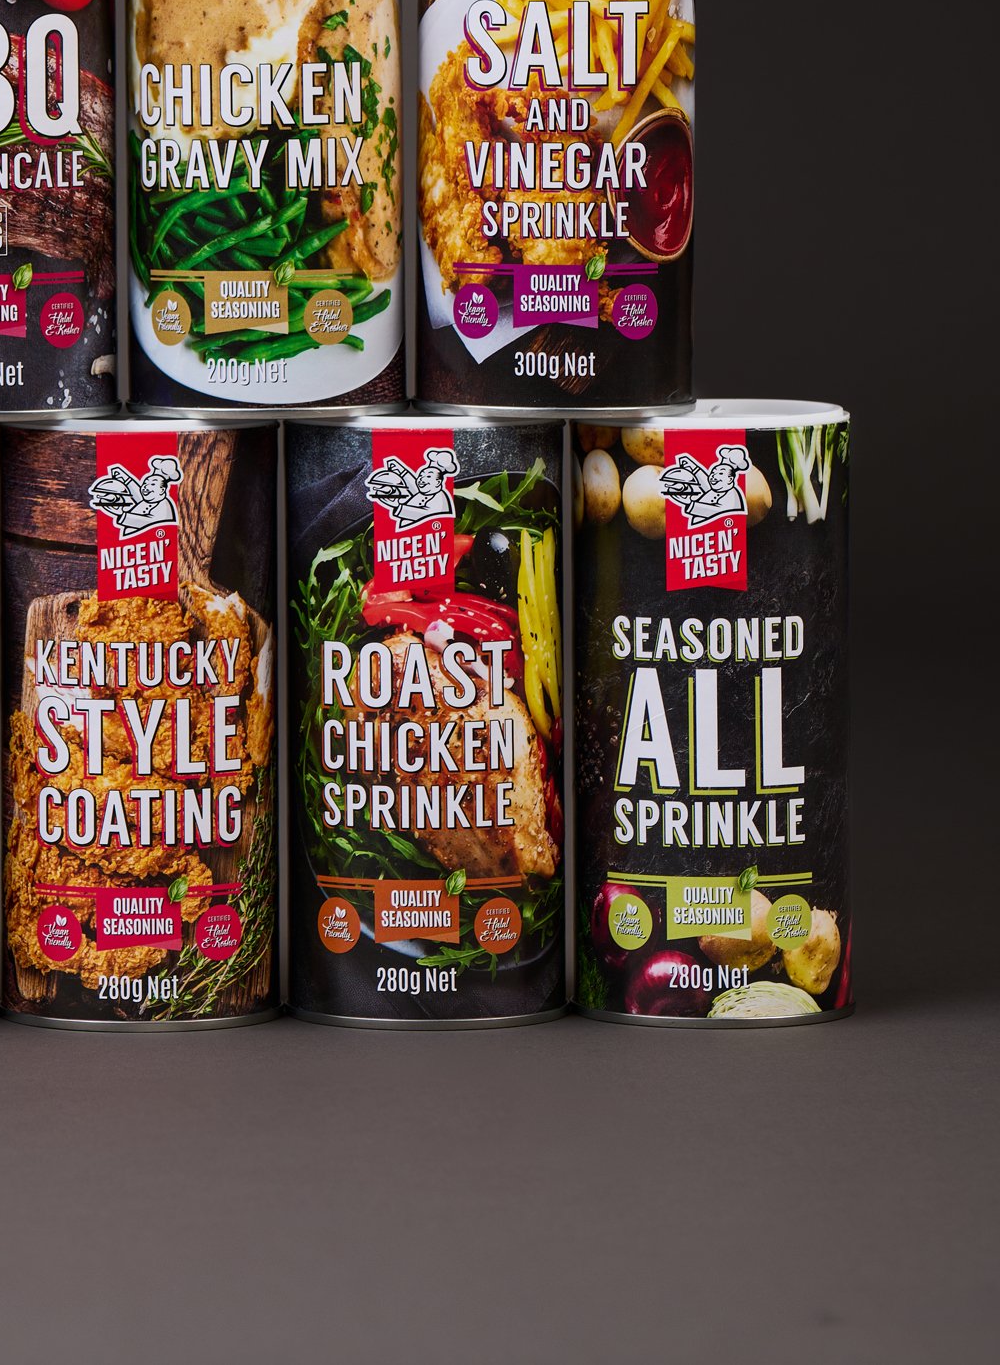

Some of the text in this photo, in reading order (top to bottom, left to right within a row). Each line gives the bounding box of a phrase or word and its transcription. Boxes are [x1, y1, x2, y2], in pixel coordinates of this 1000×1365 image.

[466, 0, 649, 86] SALT
[140, 62, 363, 125] CHICKEN
[526, 99, 589, 131] AND
[141, 137, 364, 189] GRAVY MIX
[465, 142, 647, 189] VINEGAR
[482, 202, 630, 238] SPRINKLE
[220, 281, 270, 298] QUALITY
[531, 275, 581, 292] QUALITY
[211, 301, 280, 319] SEASONING
[458, 302, 485, 315] Vegan
[521, 295, 590, 312] SEASONING
[621, 303, 646, 315] Halal
[461, 313, 492, 327] Friendly
[626, 317, 653, 327] Kosher
[207, 358, 287, 385] 200g Net
[514, 352, 595, 379] 300g Net
[101, 540, 170, 570] NICE N'
[669, 529, 739, 559] NICE N'
[113, 561, 172, 591] TASTY
[682, 551, 741, 580] TASTY
[612, 615, 803, 660] SEASONED
[36, 639, 241, 687] KENTUCKY
[323, 640, 512, 708] ROAST
[37, 695, 242, 775] STYLE
[618, 667, 805, 788] ALL
[323, 719, 514, 773] CHICKEN
[39, 786, 242, 846] COATING
[323, 782, 514, 830] SPRINKLE
[614, 798, 806, 846] SPRINKLE
[113, 898, 163, 915] QUALITY
[391, 890, 441, 908] QUALITY
[684, 887, 734, 905] QUALITY
[104, 918, 173, 935] SEASONING
[204, 924, 230, 936] Halal
[381, 911, 451, 928] SEASONING
[674, 908, 744, 925] SEASONING
[210, 937, 237, 947] Kosher
[99, 975, 179, 1002] 280g Net
[377, 967, 457, 994] 280g Net
[669, 964, 749, 992] 280g Net
